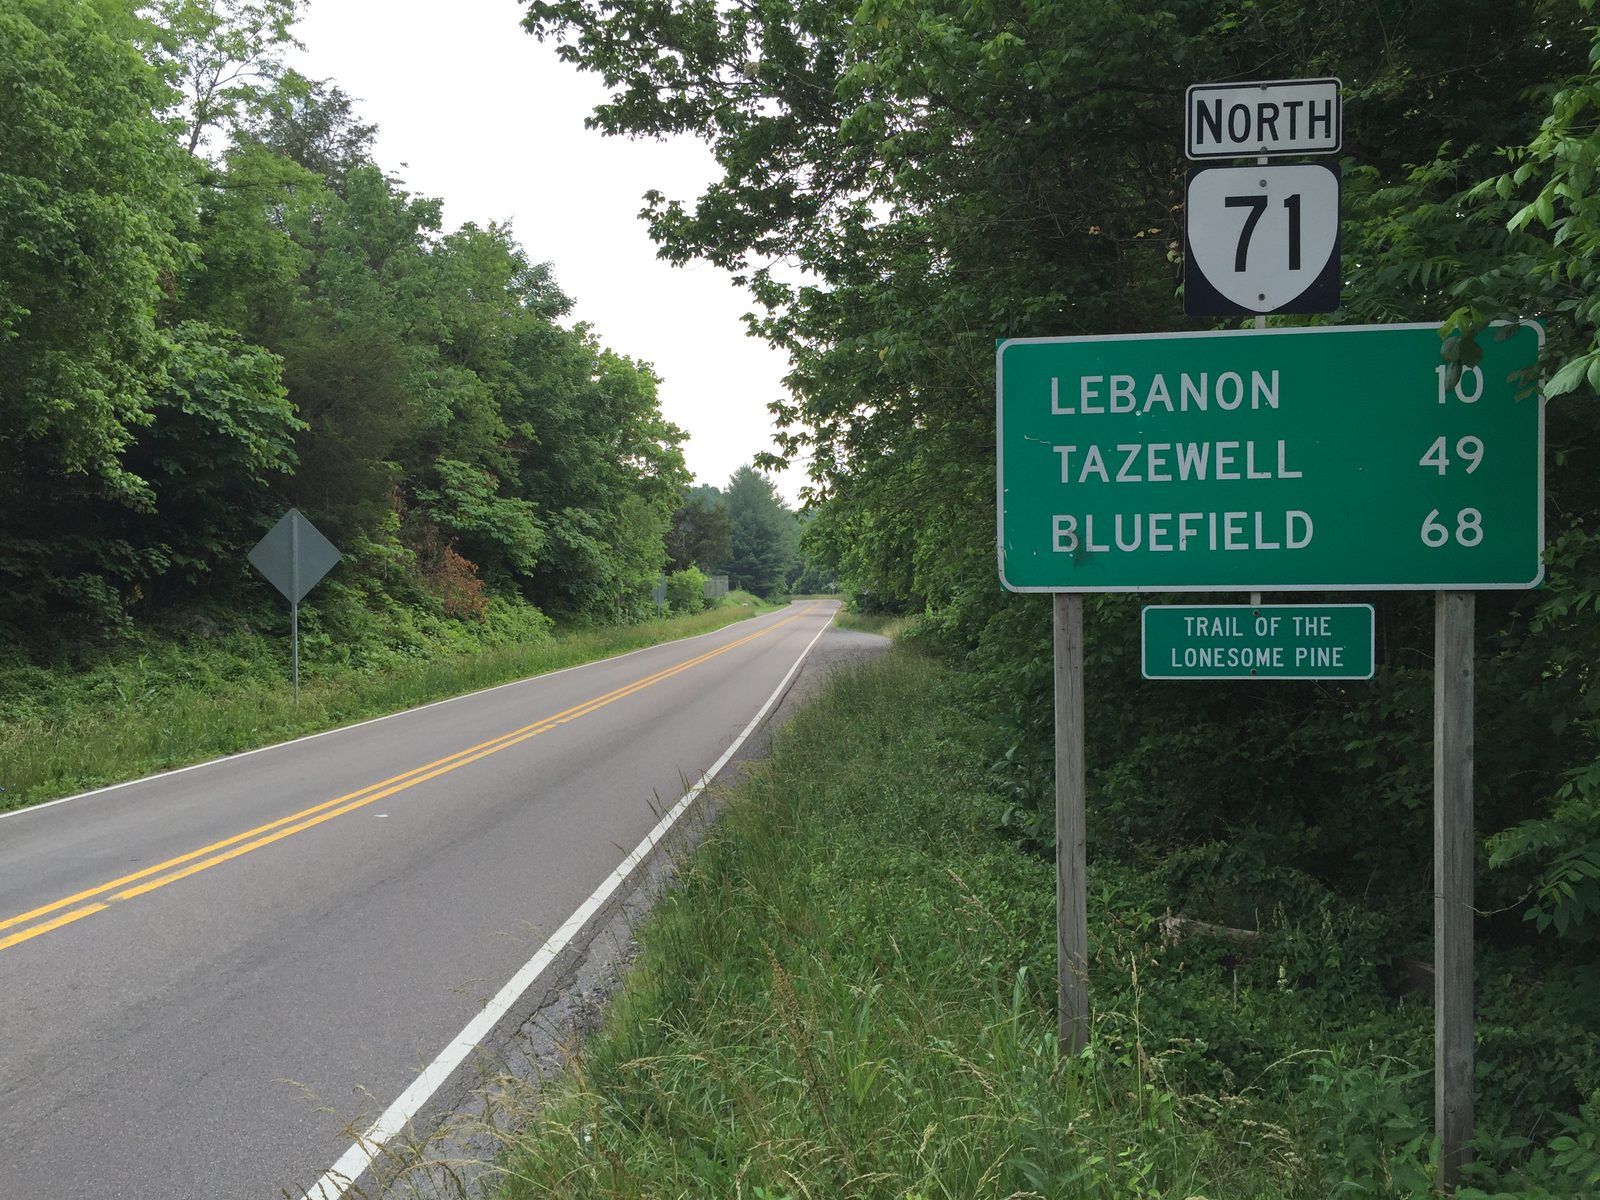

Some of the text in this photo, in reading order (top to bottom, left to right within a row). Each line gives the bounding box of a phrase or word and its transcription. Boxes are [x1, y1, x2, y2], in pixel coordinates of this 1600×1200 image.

[1196, 99, 1331, 145] NORTH
[1224, 194, 1301, 272] 71
[1051, 364, 1484, 415] LEBANON 10
[1053, 436, 1484, 484] TAZEWELL 49
[1052, 507, 1484, 553] BLUEFIELD 68
[1184, 616, 1332, 637] TRAIL OF THE
[1171, 646, 1344, 668] LONESOME PINE
